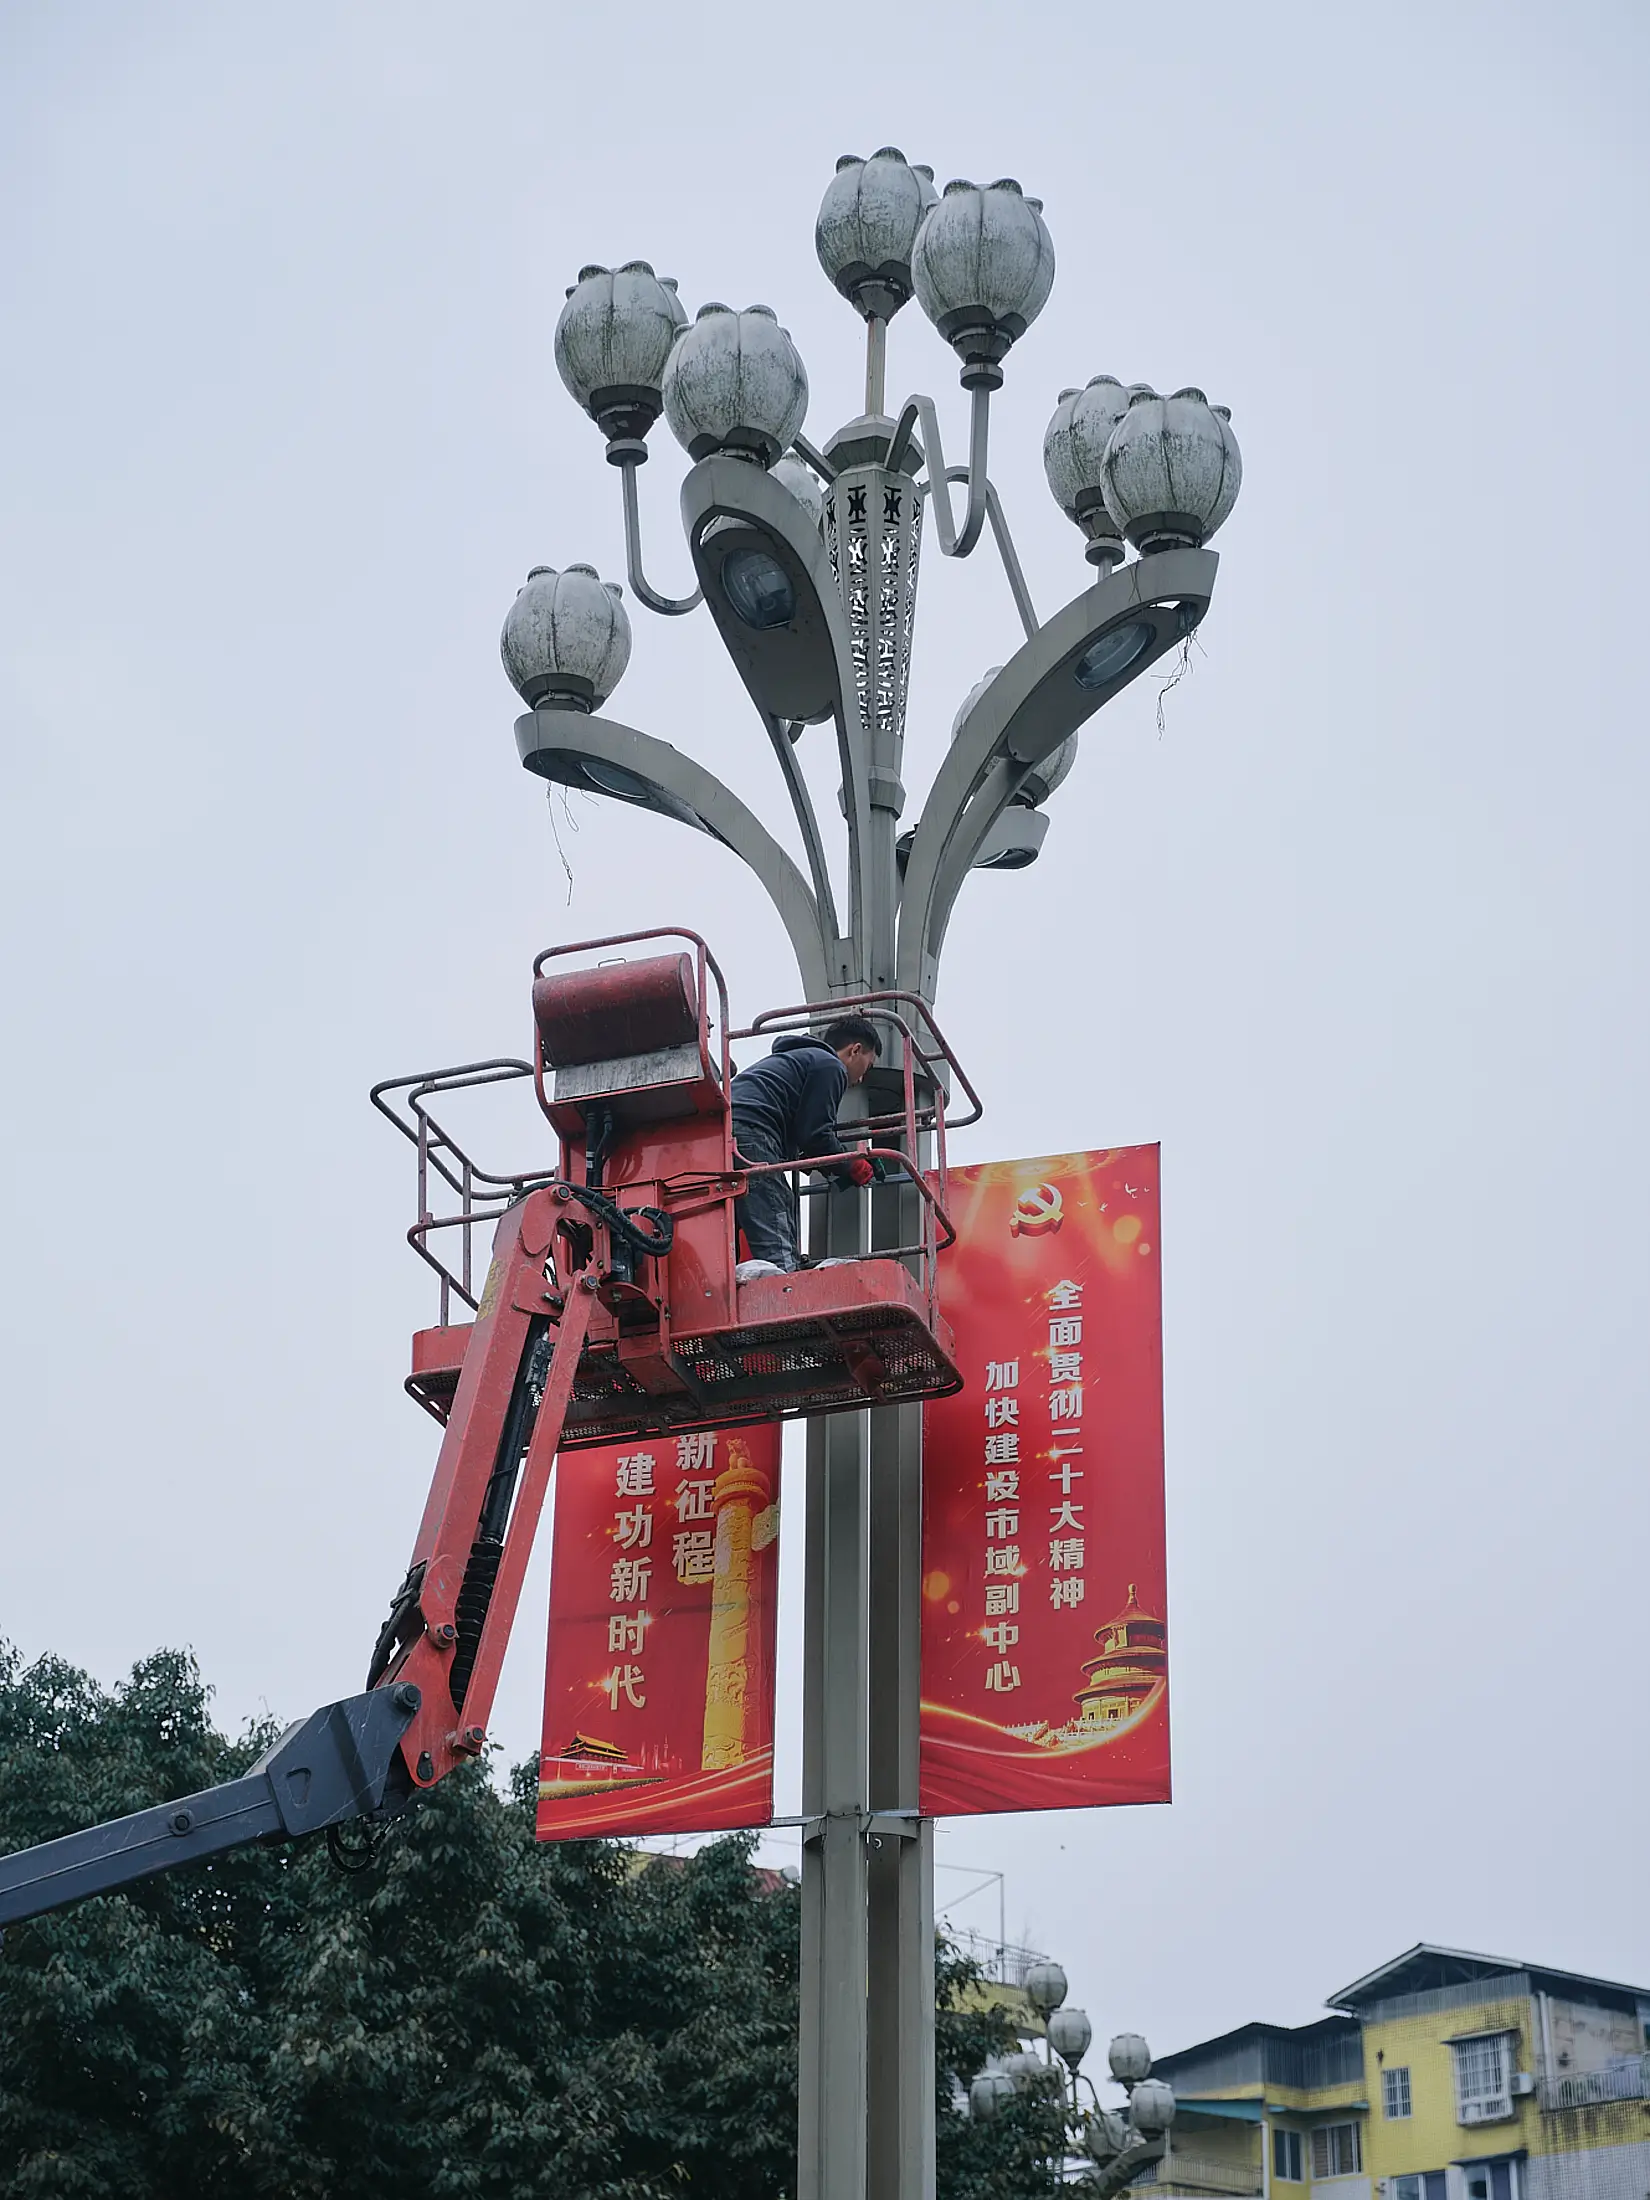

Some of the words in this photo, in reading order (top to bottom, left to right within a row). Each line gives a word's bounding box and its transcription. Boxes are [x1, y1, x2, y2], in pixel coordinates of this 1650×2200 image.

[608, 1452, 656, 1711] 建功新时代
[984, 1360, 1021, 1693] 加快建设市域副中心
[1048, 1279, 1085, 1610] 全面贯彻二十大精神
